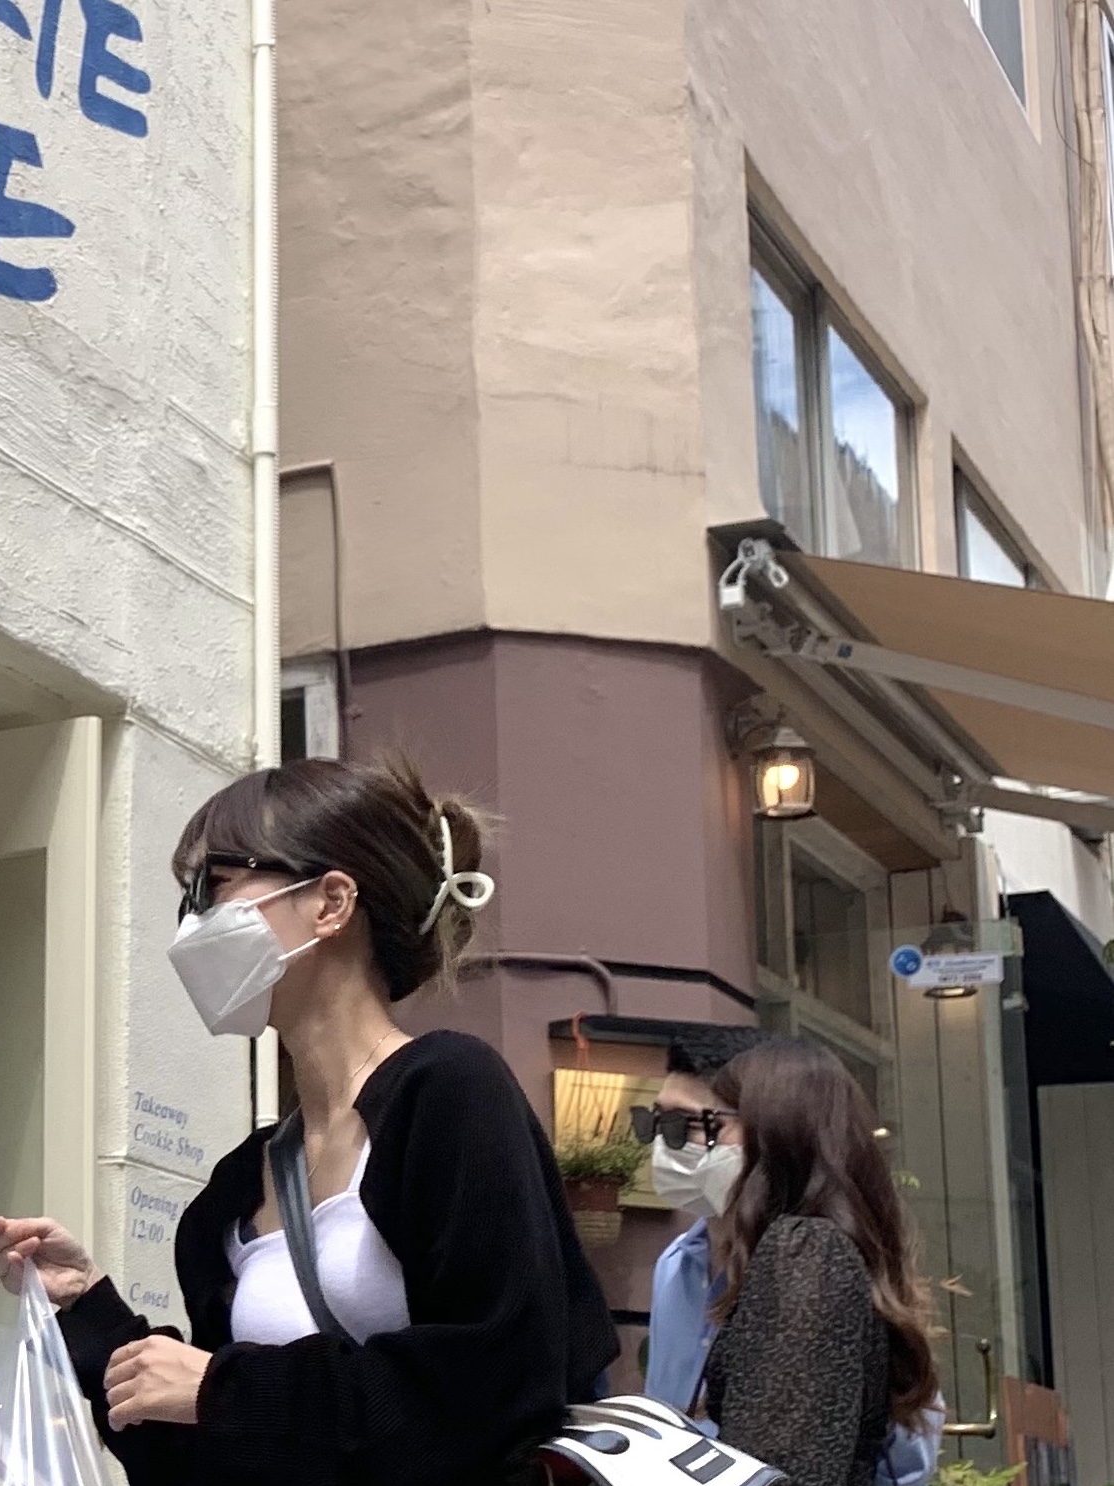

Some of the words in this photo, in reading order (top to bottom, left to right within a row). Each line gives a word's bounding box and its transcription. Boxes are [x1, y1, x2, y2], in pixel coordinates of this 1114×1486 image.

[134, 1091, 188, 1130] Takeaway
[134, 1123, 173, 1152] Cookie
[176, 1136, 205, 1167] Shop
[131, 1186, 178, 1221] Opening
[129, 1282, 171, 1309] Cosed
